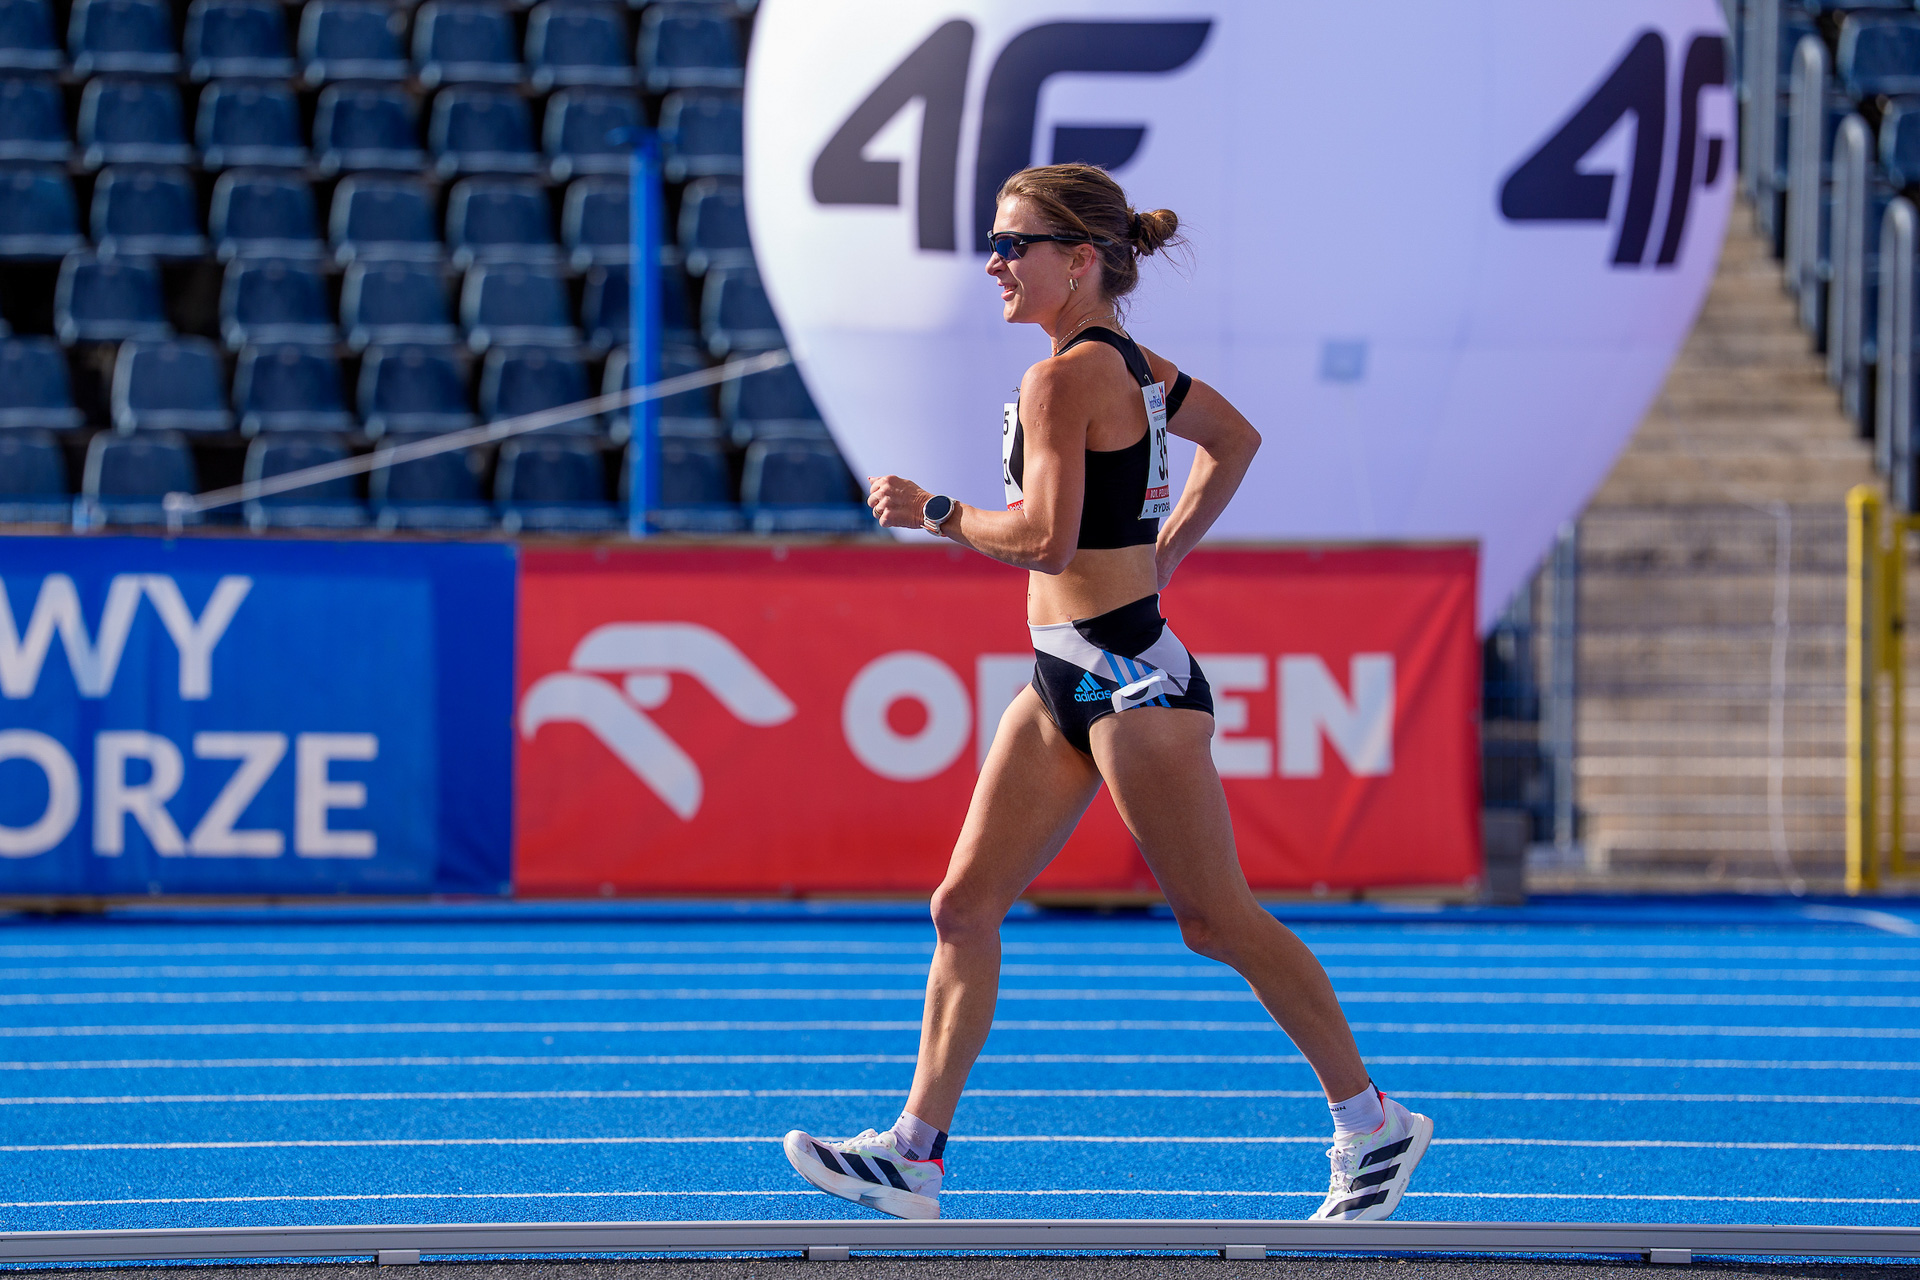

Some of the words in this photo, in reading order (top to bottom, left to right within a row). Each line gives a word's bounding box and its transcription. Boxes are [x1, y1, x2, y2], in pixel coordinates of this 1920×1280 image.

[811, 18, 1214, 253] 4F
[841, 650, 1394, 781] OEN
[1074, 689, 1111, 702] adidas
